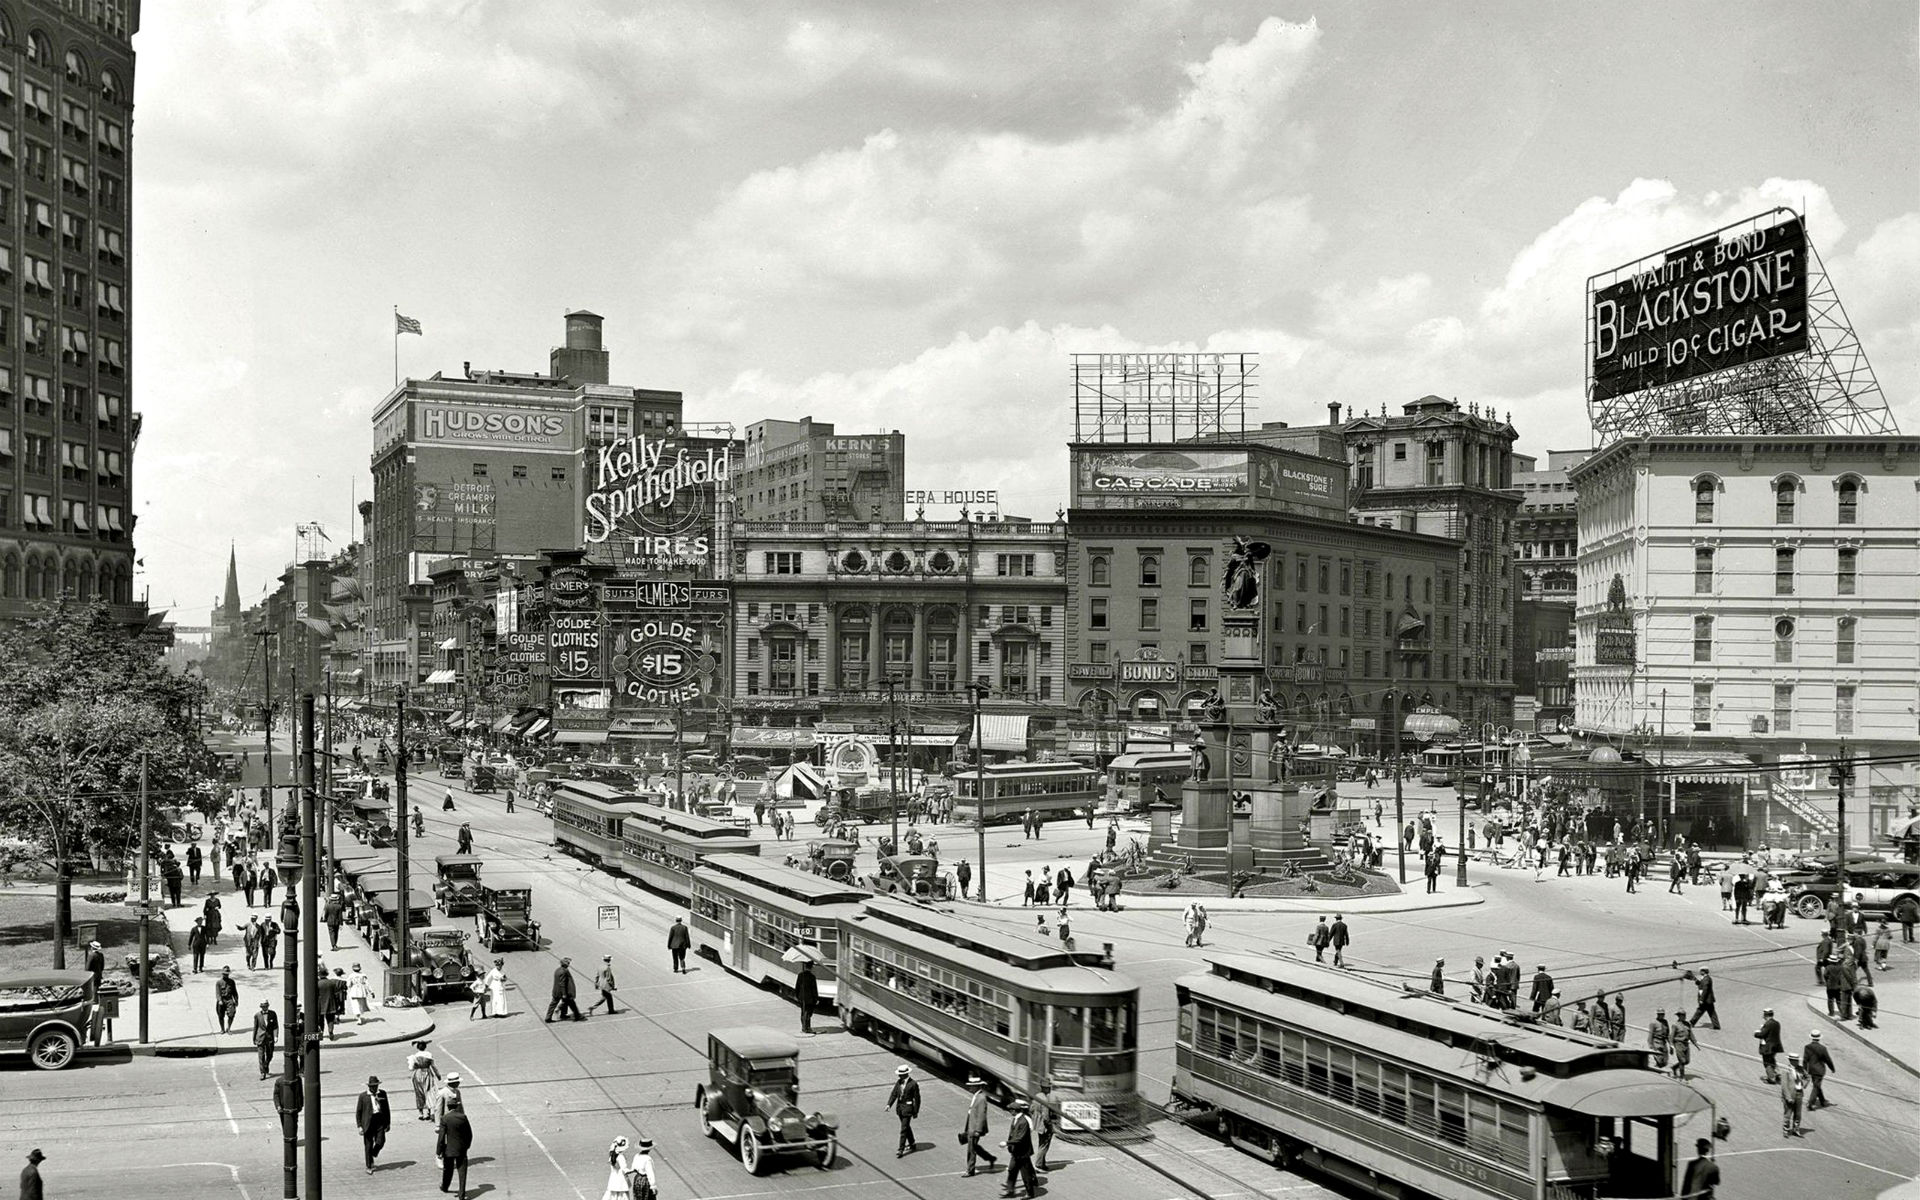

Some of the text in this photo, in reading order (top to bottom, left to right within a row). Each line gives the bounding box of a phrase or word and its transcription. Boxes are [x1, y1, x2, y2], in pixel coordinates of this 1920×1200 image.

[1631, 229, 1766, 293] WAITT & BOND
[1595, 249, 1796, 360] BLACKSTONE
[1622, 347, 1659, 371] MILD
[1707, 308, 1802, 355] CIGAR
[1123, 382, 1212, 404] FLOUR
[424, 408, 565, 439] HUDSON'S
[452, 432, 489, 440] GROWS
[514, 435, 552, 444] DETROIT
[826, 438, 891, 450] KERN'S
[1095, 477, 1212, 489] CASCADE
[1282, 469, 1328, 485] BLACKSTONE
[453, 482, 491, 493] DETROIT
[1309, 482, 1328, 493] SURE
[448, 492, 496, 502] CREAMERY
[583, 447, 730, 543] Springfield
[944, 490, 997, 503] HOUSE
[454, 503, 490, 514] MILK
[629, 536, 709, 555] TIRES
[625, 557, 646, 565] MADE
[650, 557, 659, 565] TO
[687, 557, 706, 566] GOOD
[550, 581, 590, 591] ELMER'S
[605, 590, 635, 598] SUITS
[638, 582, 689, 608] ELMER'S
[695, 591, 724, 600] FURS
[556, 619, 591, 629] GOLDE
[631, 621, 697, 644] GOLDE
[510, 634, 545, 645] GOLDE
[551, 632, 599, 648] CLOTHES
[510, 652, 546, 662] CLOTHES
[560, 650, 589, 672] $15
[642, 654, 682, 676] $15
[1123, 661, 1175, 680] BOND'S
[627, 682, 700, 705] CLOTHES
[304, 1033, 319, 1041] FORT
